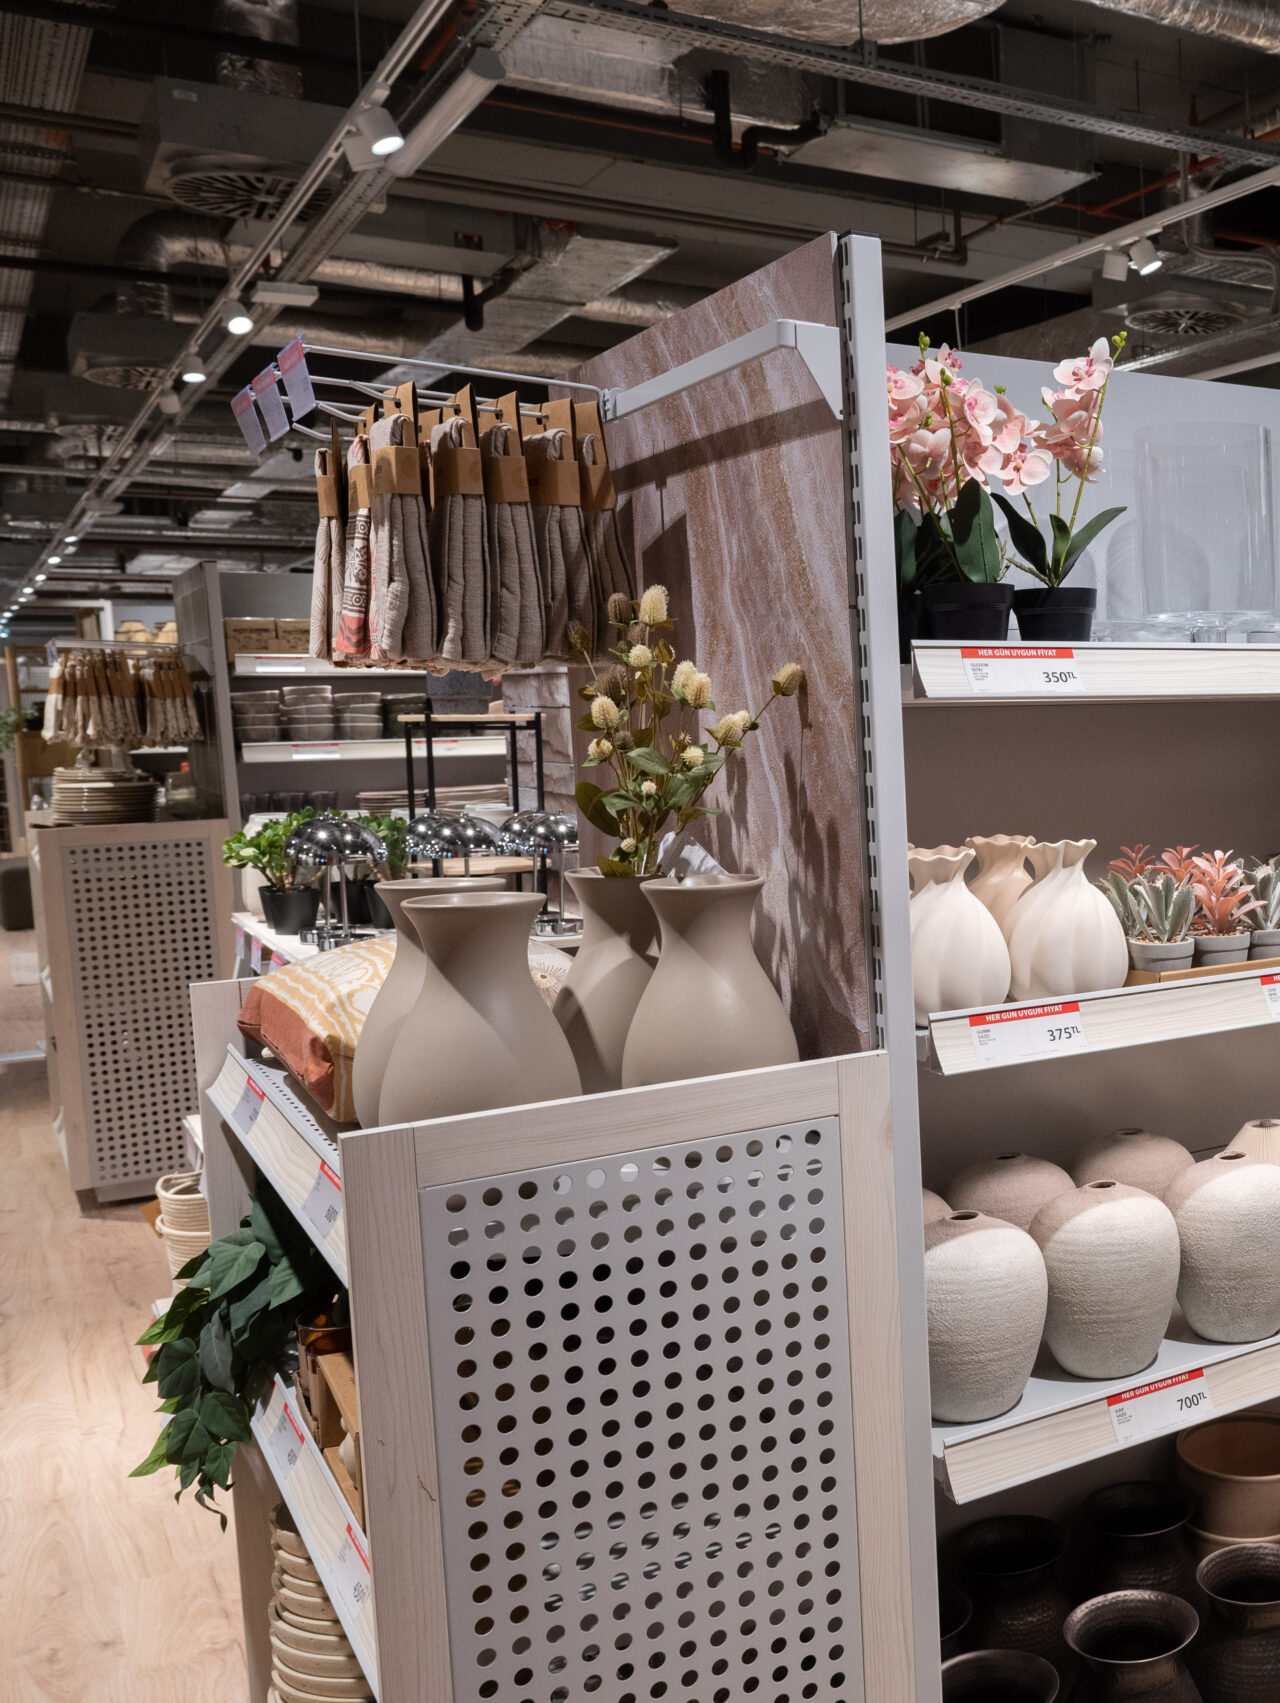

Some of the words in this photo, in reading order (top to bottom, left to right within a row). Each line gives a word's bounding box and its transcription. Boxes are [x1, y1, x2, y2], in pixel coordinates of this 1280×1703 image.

[1042, 672, 1077, 683] 350TL
[986, 1013, 1000, 1021] HER
[1018, 1007, 1043, 1017] UYGUN
[1047, 1025, 1081, 1041] 375TL
[1121, 1390, 1134, 1400] HER
[1150, 1378, 1172, 1391] UYGUN
[1177, 1392, 1207, 1411] 700TL
